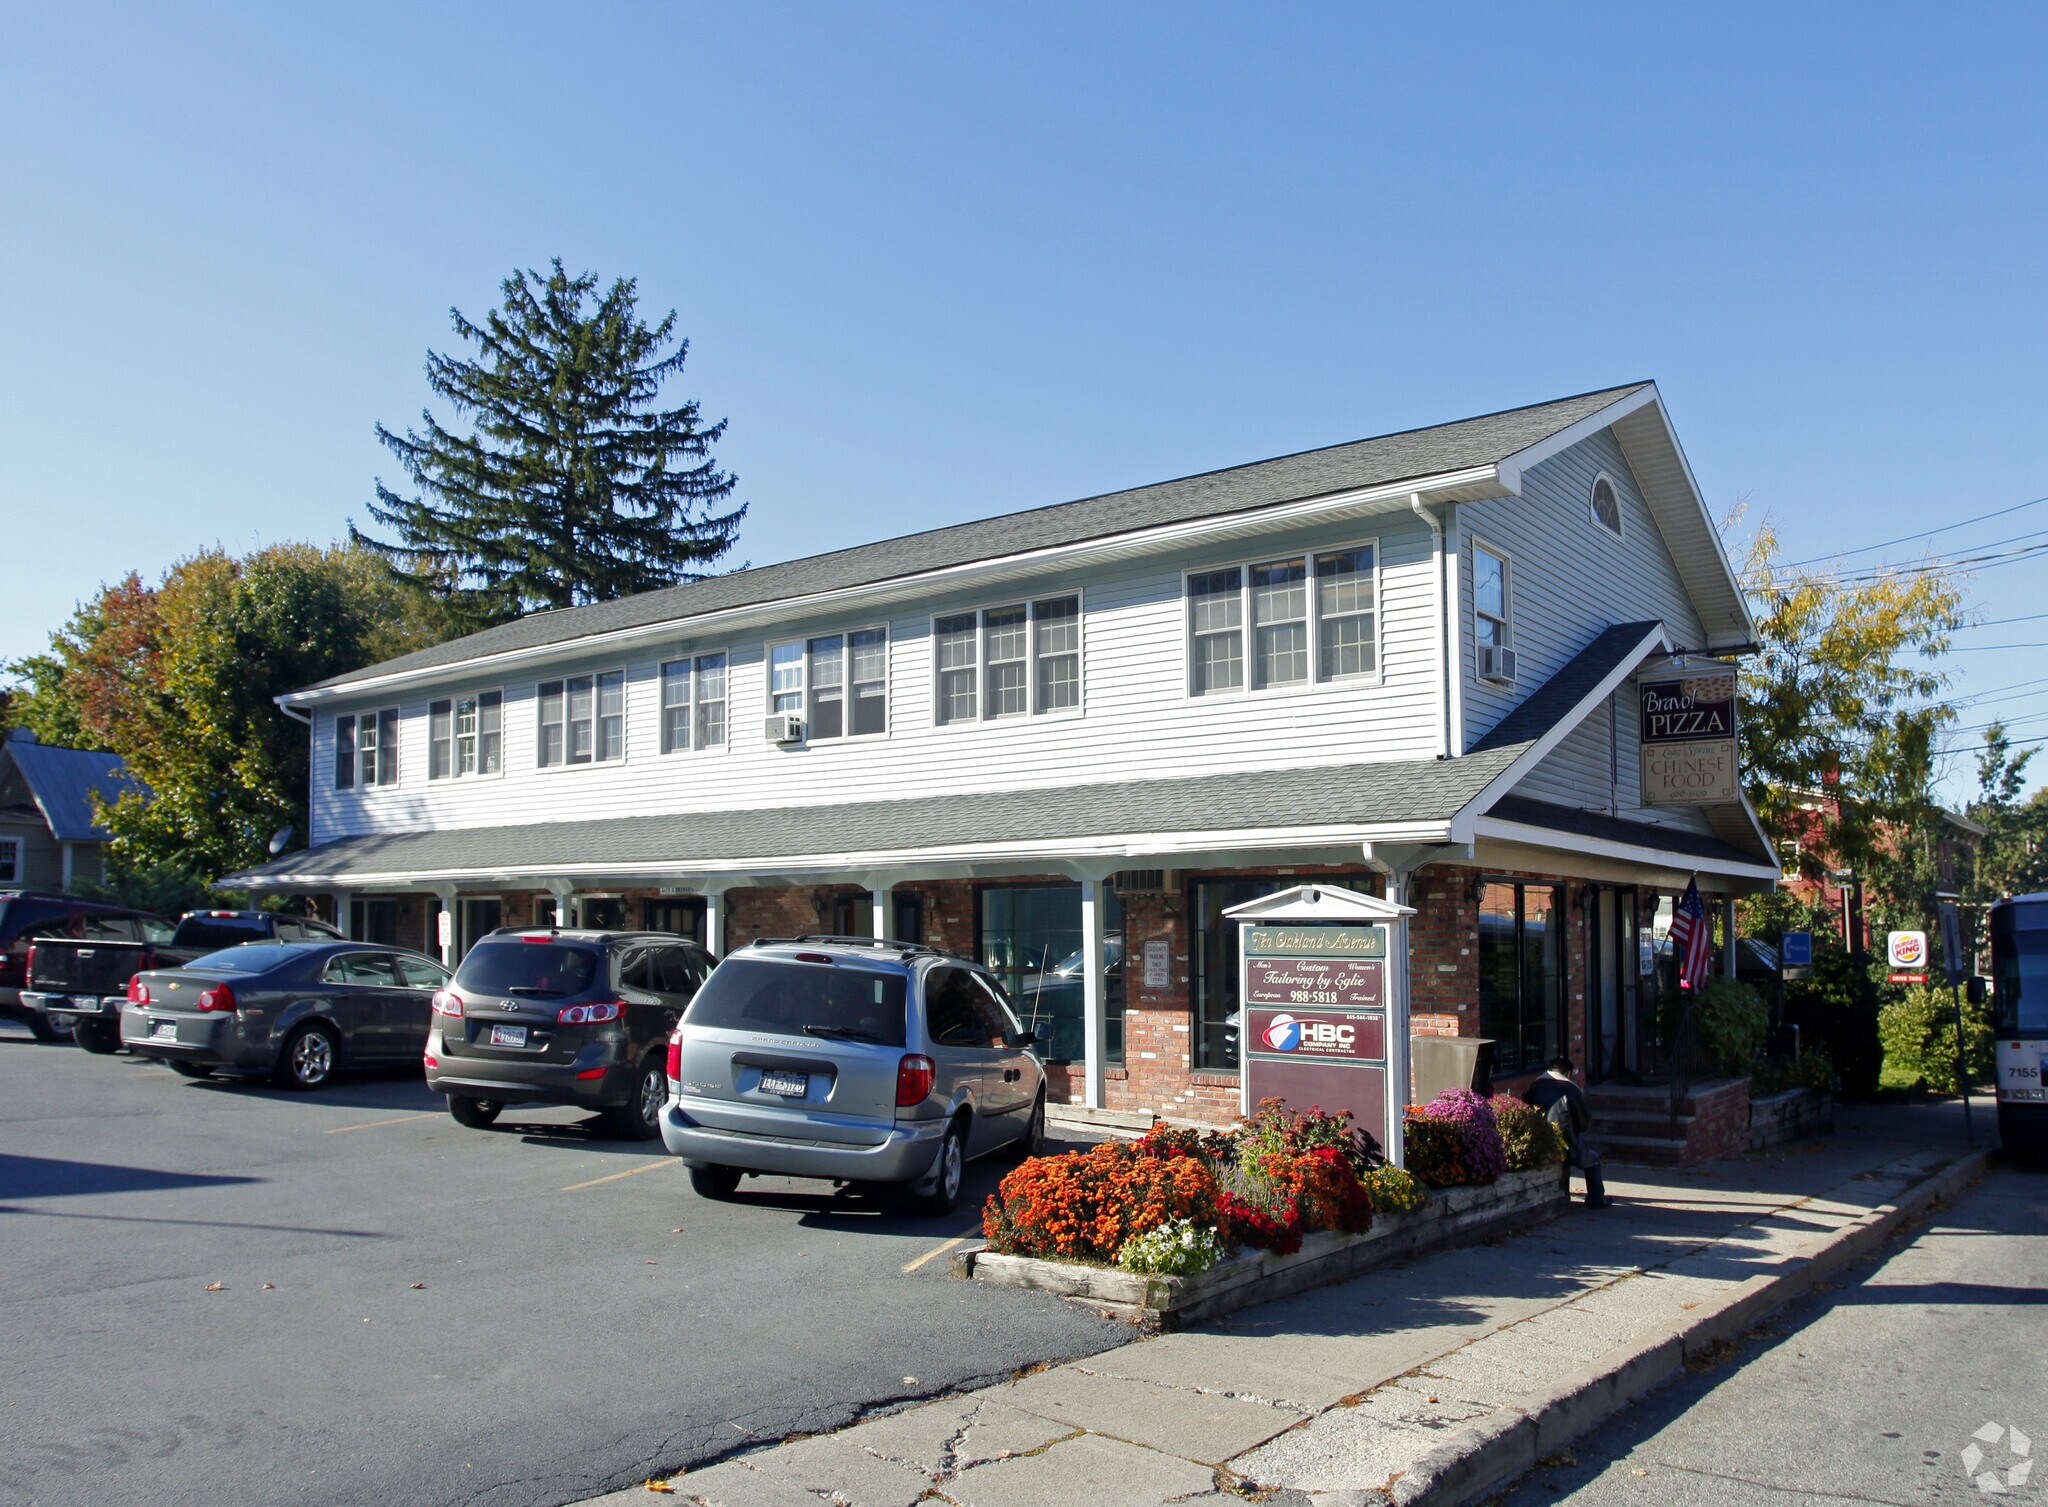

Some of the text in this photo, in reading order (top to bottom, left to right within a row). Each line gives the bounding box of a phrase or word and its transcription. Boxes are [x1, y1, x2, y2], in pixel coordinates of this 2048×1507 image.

[1643, 689, 1698, 712] Bravo!
[1650, 710, 1725, 736] PIZZA
[1651, 756, 1725, 775] CHINESE
[1663, 772, 1715, 788] FOOD
[1251, 932, 1376, 951] Ten Oakland Avenue
[1894, 939, 1918, 950] BURGER
[1896, 945, 1919, 956] KING
[1253, 961, 1272, 969] Men's
[1296, 961, 1330, 972] Custom
[1347, 963, 1376, 971] Women's
[1263, 971, 1366, 990] Tailoring by Eglie
[1253, 990, 1281, 1000] European
[1349, 993, 1377, 1001] Trained
[1300, 1023, 1356, 1044] HBC
[2008, 1067, 2038, 1078] 7155
